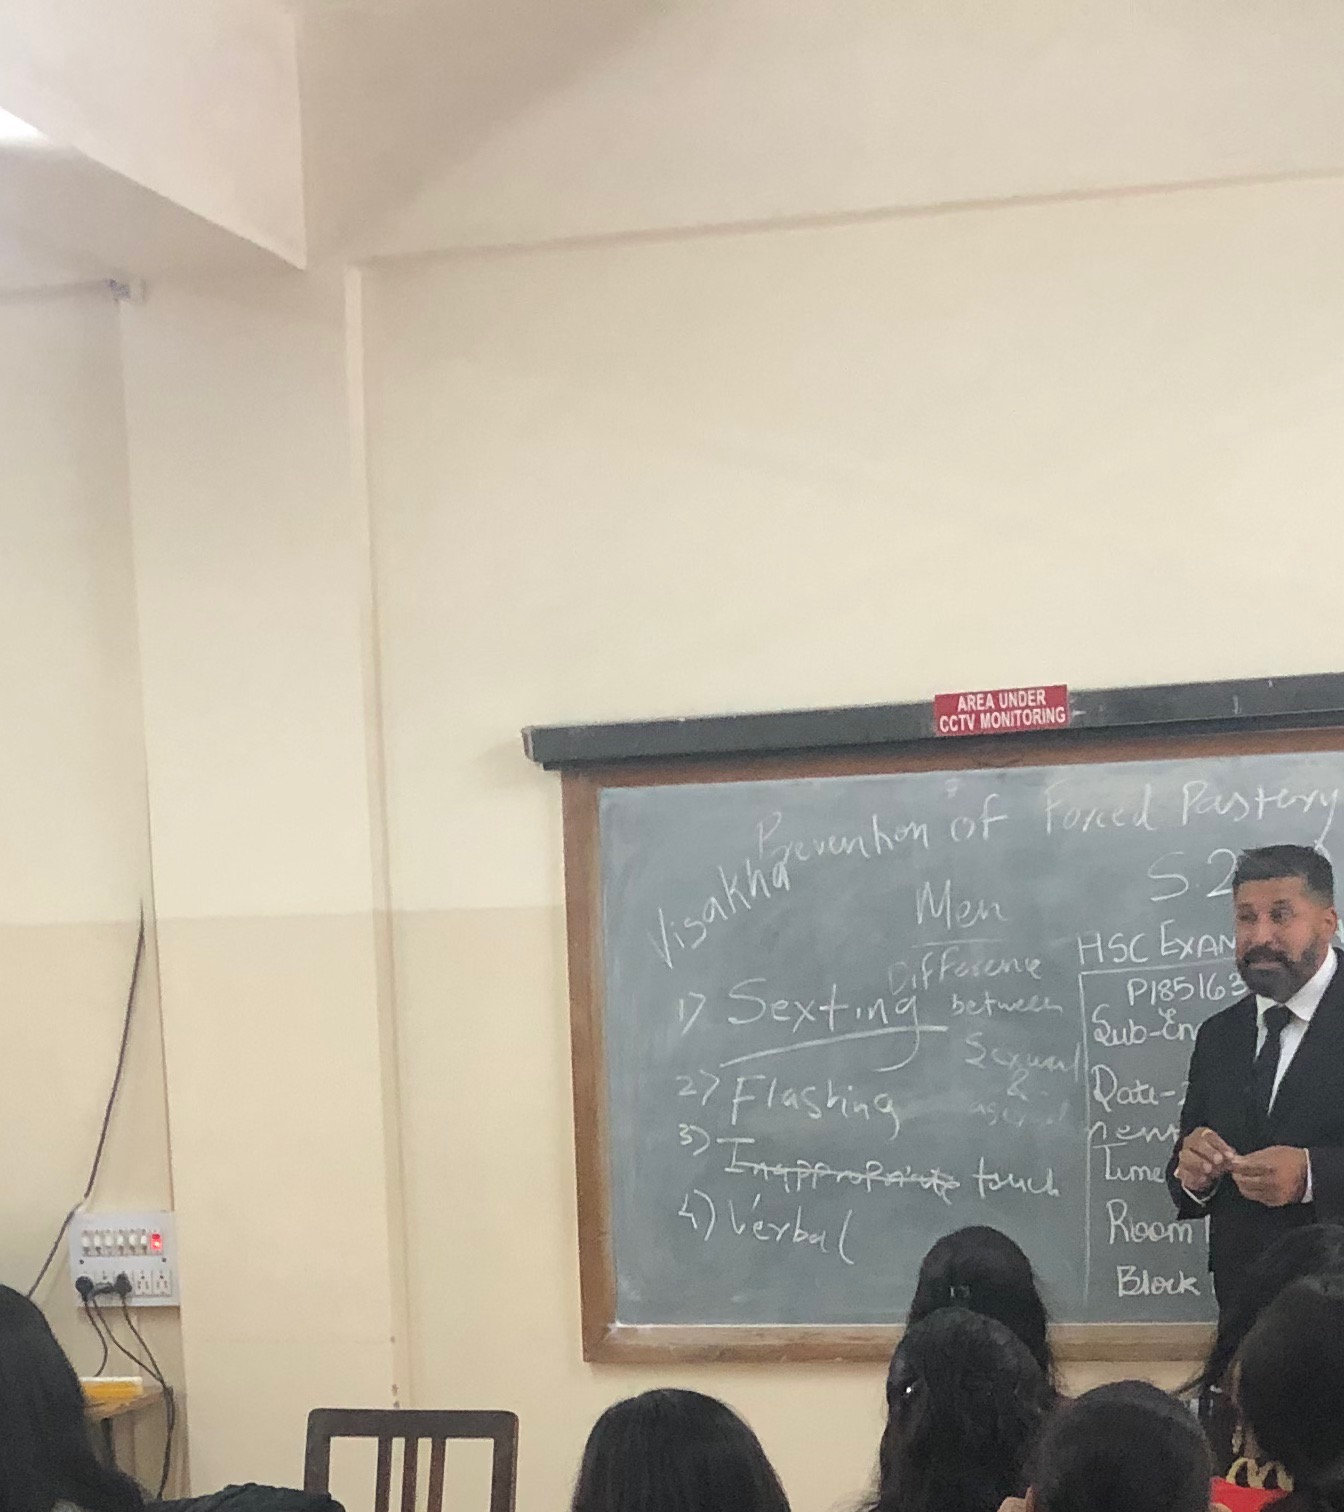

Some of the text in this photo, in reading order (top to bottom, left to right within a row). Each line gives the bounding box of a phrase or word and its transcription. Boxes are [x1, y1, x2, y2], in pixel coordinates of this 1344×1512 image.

[957, 688, 1046, 713] AREA UNDER
[939, 706, 1066, 733] CCTV MONITORING
[950, 793, 1008, 842] of
[1077, 930, 1149, 965] HSC
[730, 1074, 901, 1141] Flashing
[1106, 1198, 1193, 1245] Room
[1116, 1265, 1202, 1298] Block
